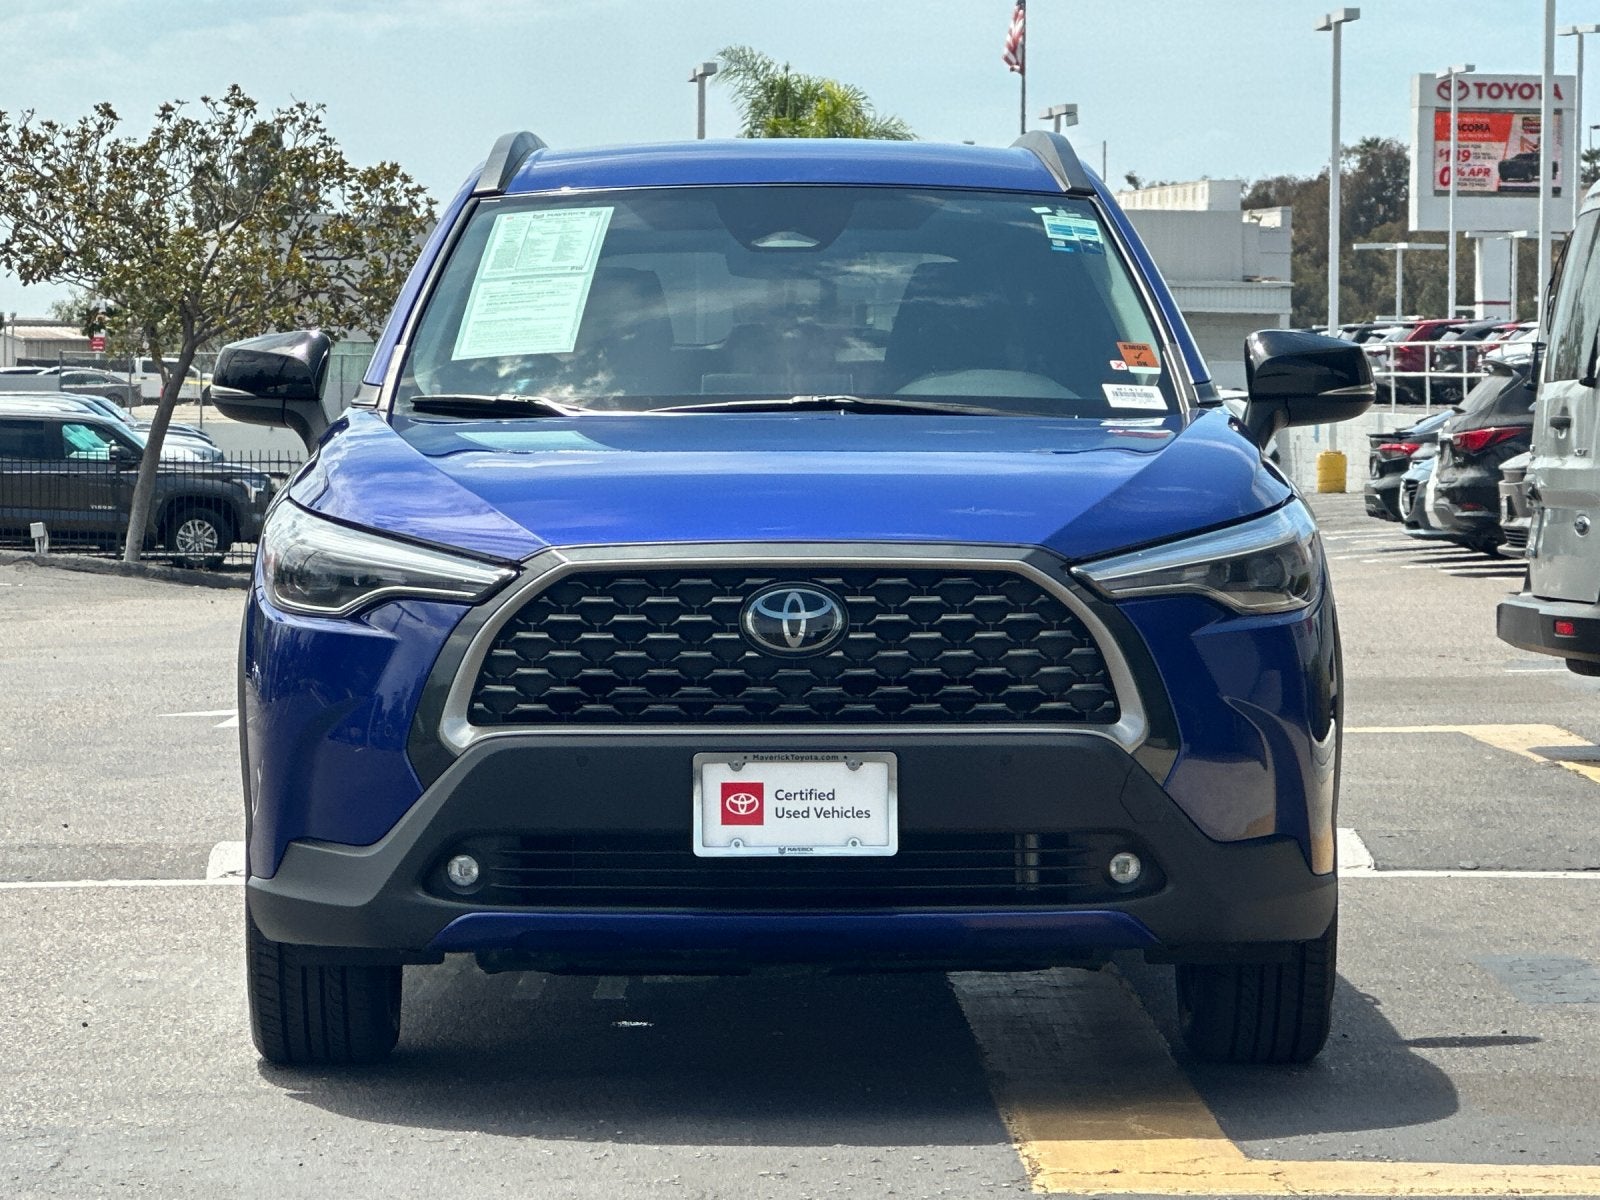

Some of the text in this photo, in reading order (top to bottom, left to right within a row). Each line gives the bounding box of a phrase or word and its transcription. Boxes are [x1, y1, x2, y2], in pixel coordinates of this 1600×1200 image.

[1450, 123, 1491, 132] ACOMA
[1468, 168, 1491, 177] APR
[752, 753, 839, 761] MaverickToyota.com
[774, 788, 836, 801] Certified
[775, 806, 871, 819] Used Vehicles
